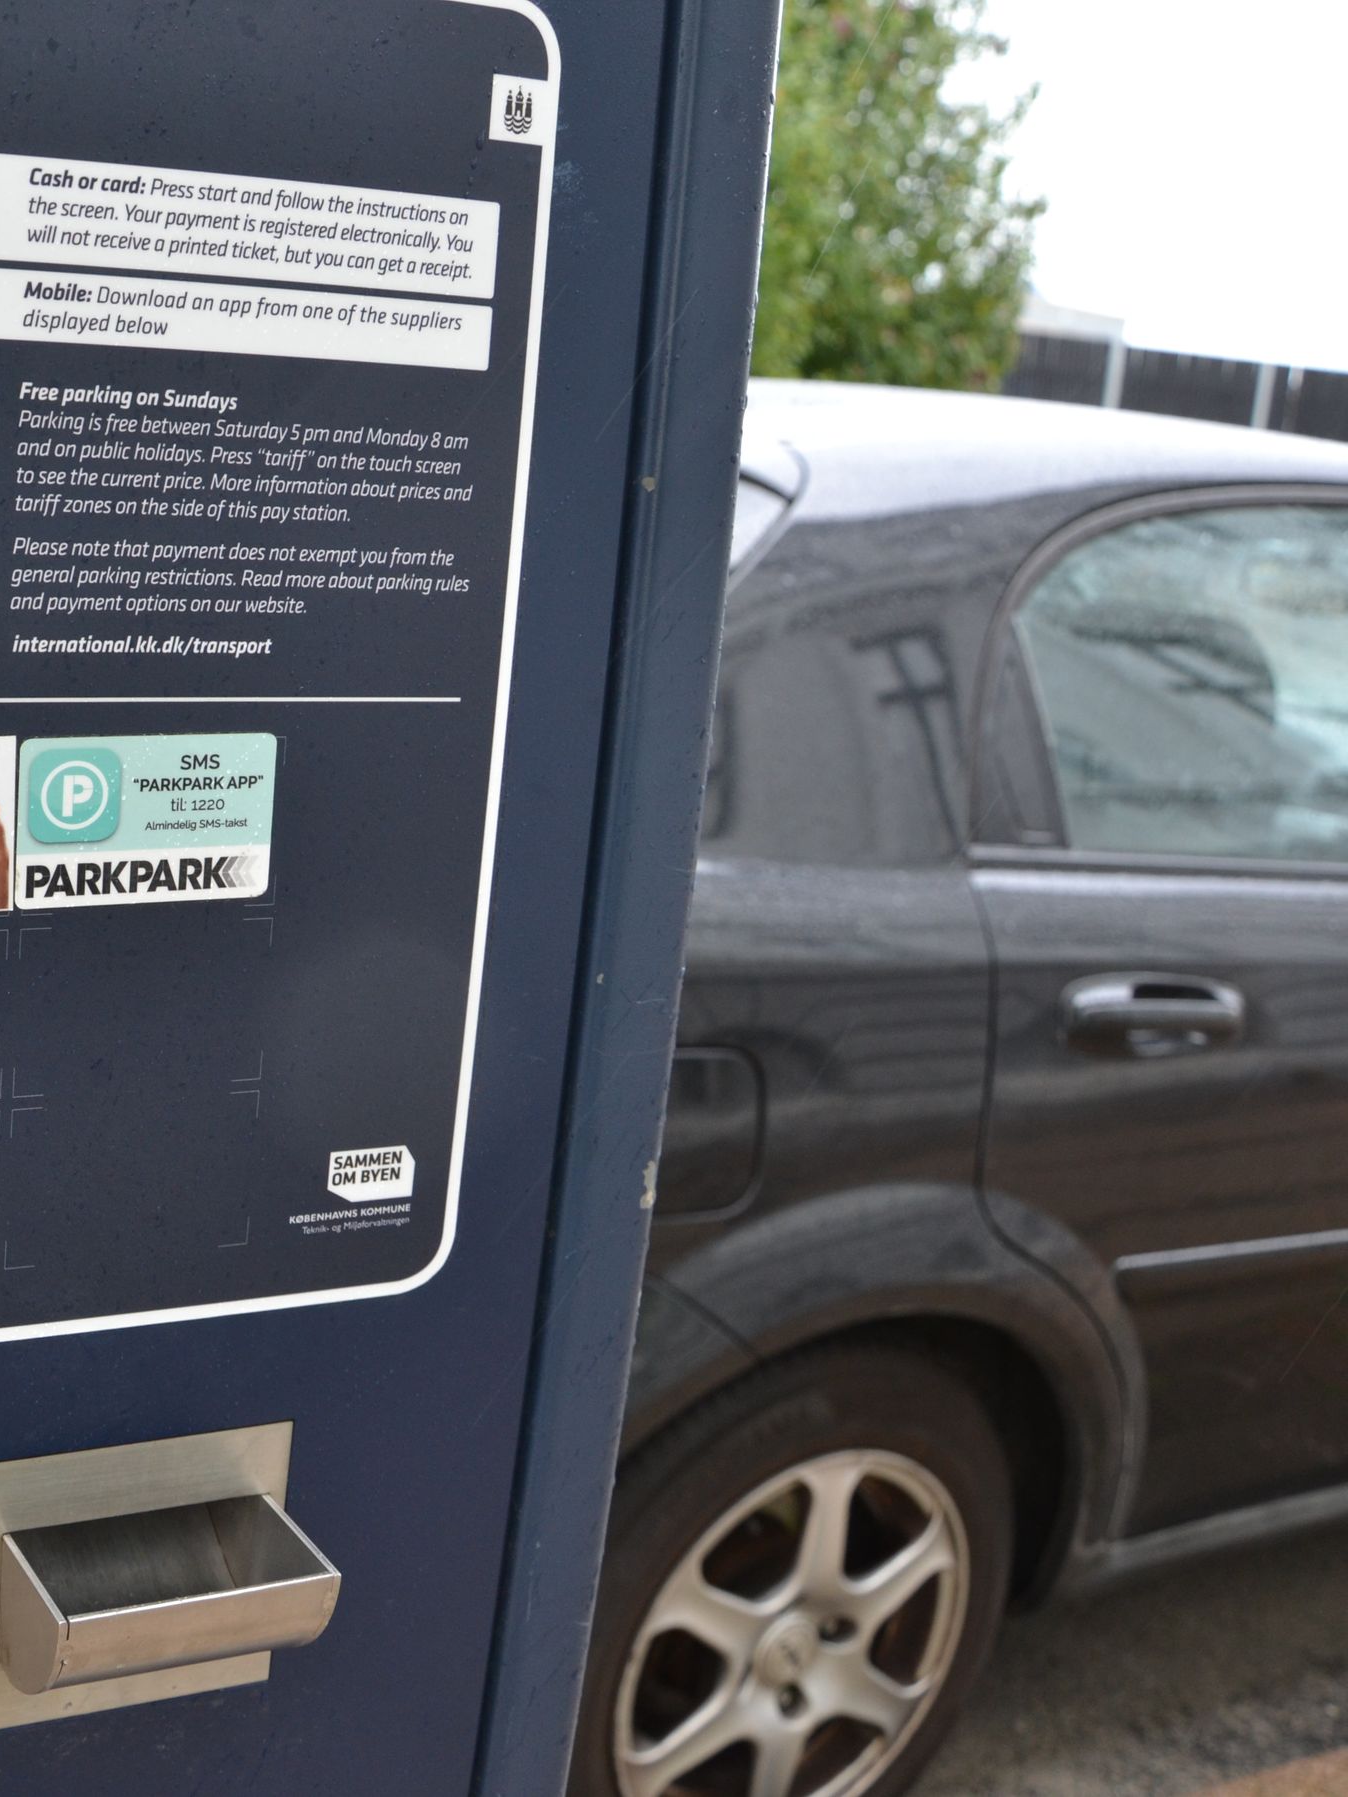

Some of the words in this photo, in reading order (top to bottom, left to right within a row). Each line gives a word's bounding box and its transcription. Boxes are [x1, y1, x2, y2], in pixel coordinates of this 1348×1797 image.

[30, 168, 73, 188] Cash
[78, 176, 98, 190] or
[101, 176, 146, 194] card:
[150, 178, 194, 198] Press
[198, 185, 238, 202] start
[241, 189, 273, 206] and
[275, 190, 324, 211] follow
[328, 196, 354, 214] the
[357, 198, 446, 223] instructions
[450, 212, 468, 226] on
[24, 282, 92, 302] Mobile:
[97, 286, 188, 308] Download
[192, 297, 214, 310] an
[219, 300, 251, 318] app
[256, 297, 297, 318] from
[303, 306, 333, 320] one
[338, 304, 357, 325] of
[360, 306, 386, 324] the
[391, 312, 462, 332] suppliers
[23, 310, 110, 334] displayed
[116, 315, 168, 335] below
[20, 382, 58, 400] Free
[62, 385, 132, 409] parking
[136, 392, 159, 406] on
[163, 390, 238, 414] Sundays
[19, 410, 84, 434] Parking
[89, 413, 102, 431] is
[105, 413, 138, 435] free
[141, 416, 210, 436] between
[214, 420, 288, 443] Saturday
[290, 424, 301, 440] 5
[302, 428, 329, 445] pm
[333, 427, 364, 443] and
[366, 428, 428, 451] Monday
[431, 432, 441, 448] 8
[444, 436, 468, 449] am
[13, 635, 272, 658] international.kk.dk/transport
[180, 754, 220, 770] SMS
[62, 775, 94, 817] P
[171, 799, 187, 812] til:
[191, 798, 225, 811] 1220
[145, 820, 196, 832] Almindelig
[199, 818, 247, 829] SMS-takst
[25, 856, 228, 899] PARKPARK
[334, 1151, 402, 1170] SAMMEN
[332, 1171, 355, 1186] OM
[361, 1167, 400, 1183] BYEN
[289, 1209, 357, 1225] KØBENHAVNS
[360, 1203, 411, 1216] KOMMUNE
[332, 1225, 341, 1234] og
